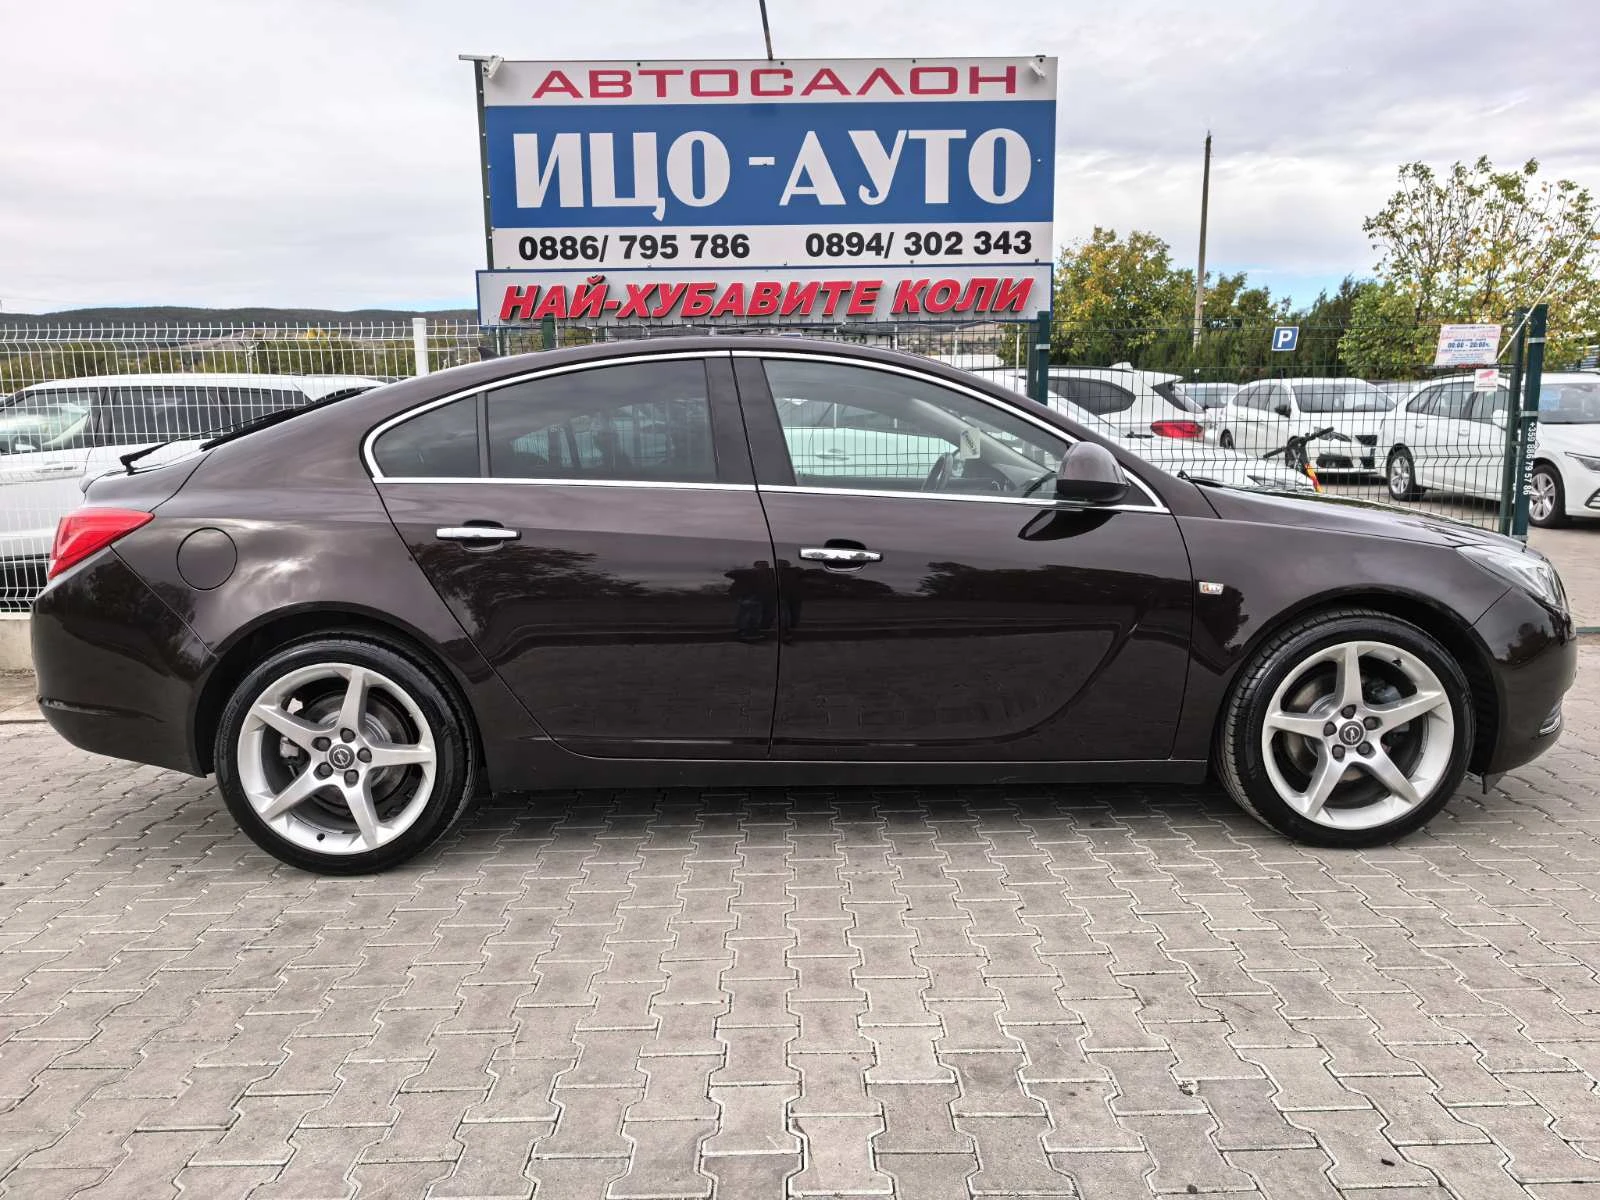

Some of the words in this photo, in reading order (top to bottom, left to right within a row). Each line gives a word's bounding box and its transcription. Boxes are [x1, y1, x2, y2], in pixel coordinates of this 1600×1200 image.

[532, 66, 1017, 99] АВТОСАЛОН
[513, 130, 731, 221] ИЦО
[518, 233, 608, 262] 0886/
[619, 234, 679, 259] 795
[690, 233, 750, 259] 786
[805, 232, 895, 261] 0894/
[904, 231, 963, 256] 302
[973, 230, 1032, 256] 343
[499, 276, 883, 321] НАЙ-ХУБАВИТЕ
[891, 277, 1035, 314] КОЛИ
[1277, 330, 1293, 348] P
[1524, 473, 1533, 483] 57
[1525, 461, 1534, 470] 79
